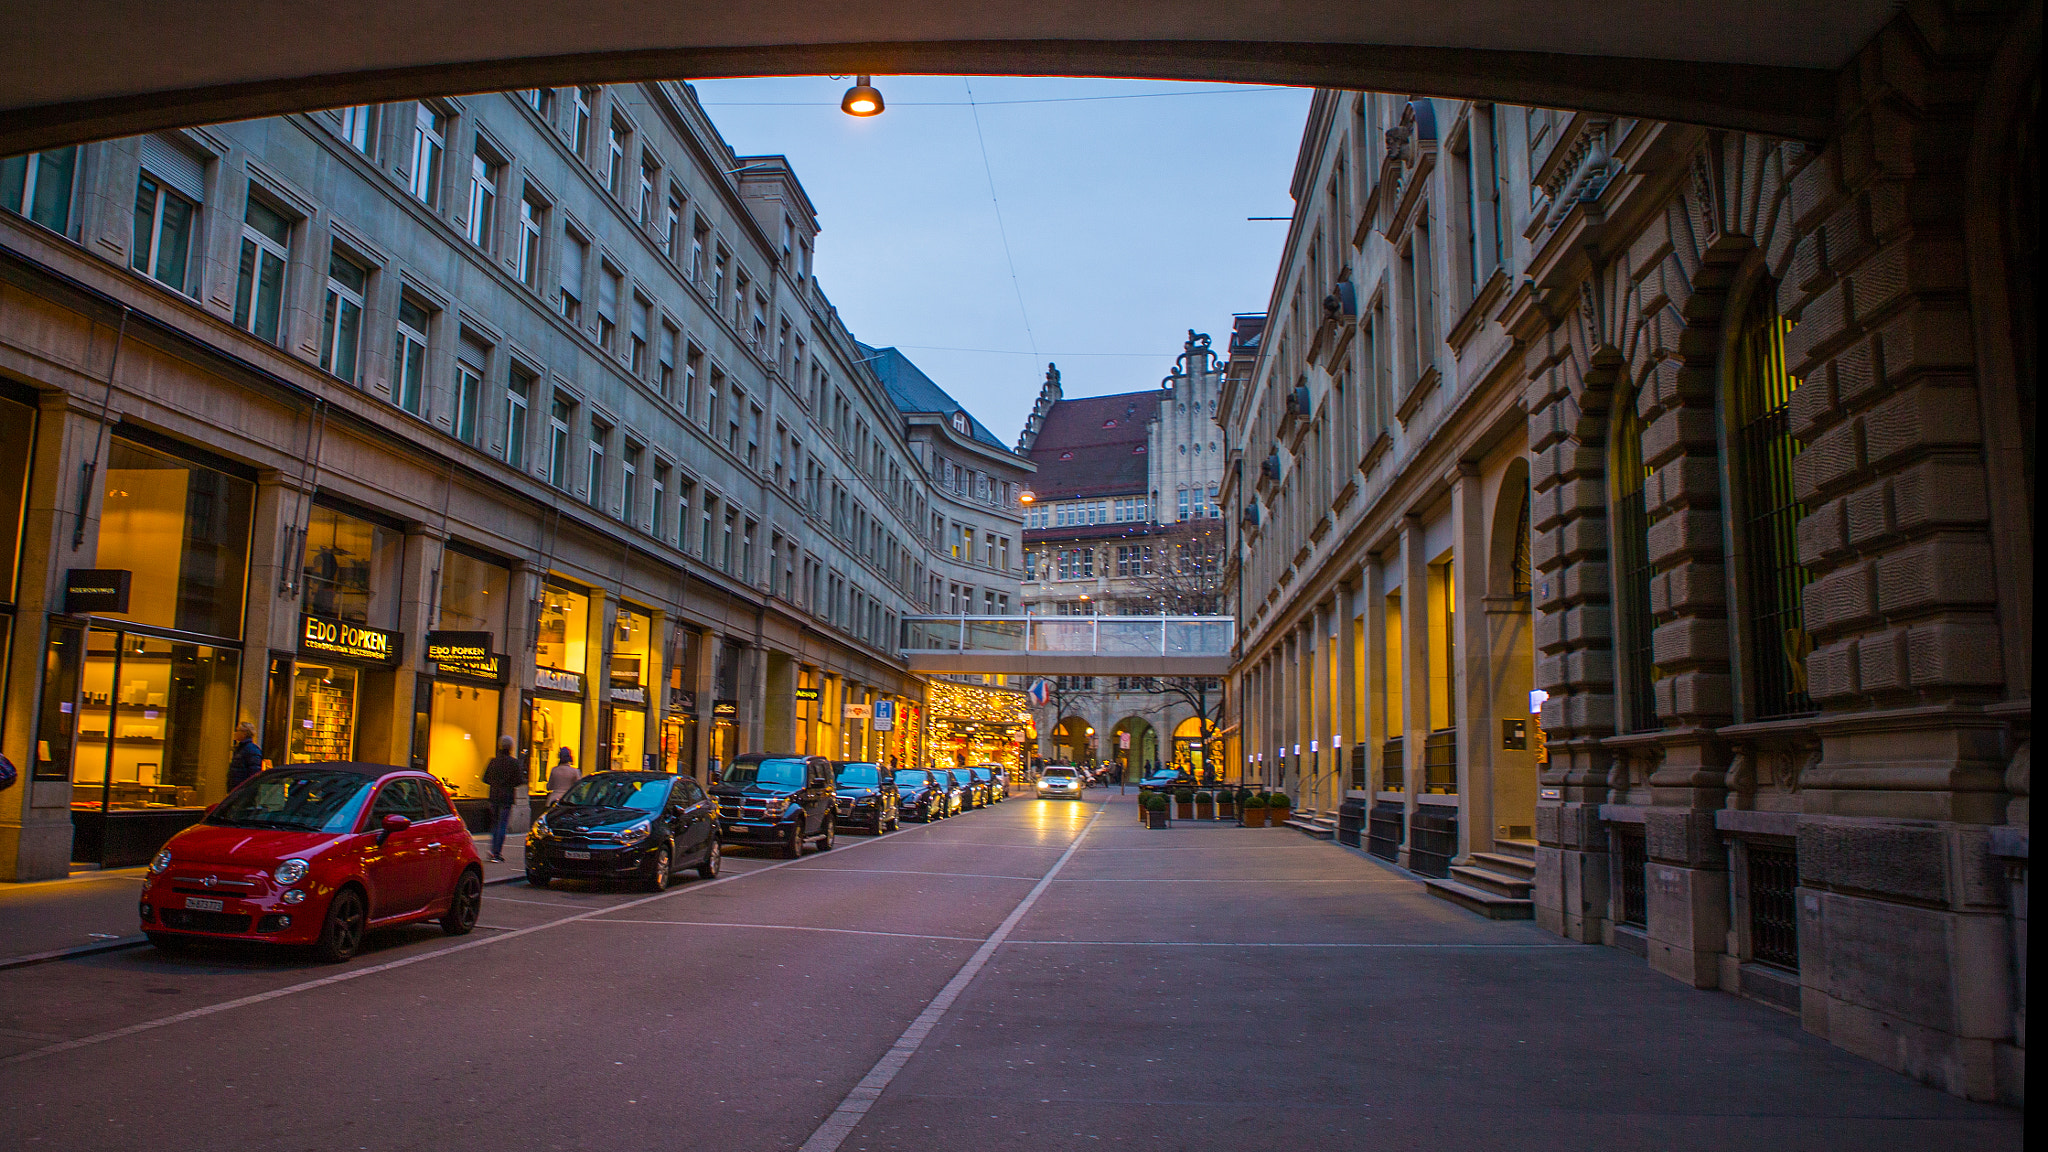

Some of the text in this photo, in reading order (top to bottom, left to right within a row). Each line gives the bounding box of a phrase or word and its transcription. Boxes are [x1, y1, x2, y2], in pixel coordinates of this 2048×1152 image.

[306, 617, 387, 651] EDO POPKEN
[429, 645, 486, 656] EDO POPKEN
